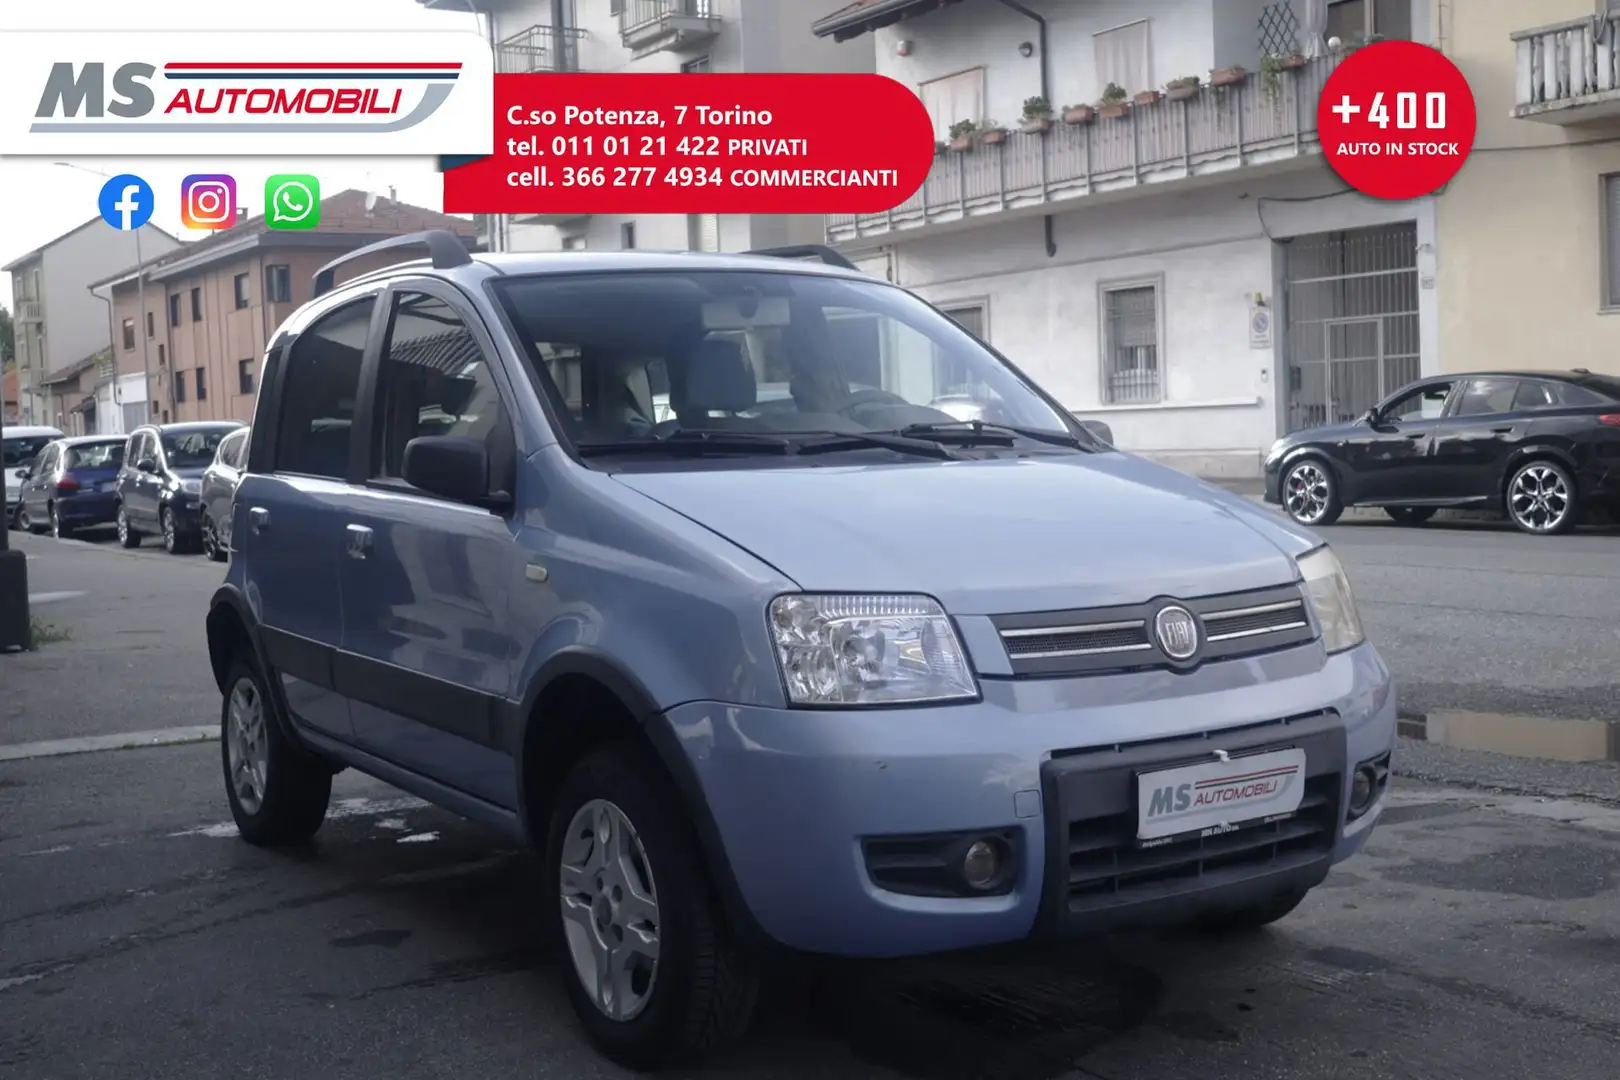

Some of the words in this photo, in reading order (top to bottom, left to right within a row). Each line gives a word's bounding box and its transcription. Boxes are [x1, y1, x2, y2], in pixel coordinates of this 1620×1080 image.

[1164, 621, 1190, 646] FIAT
[1148, 783, 1191, 818] MS
[1194, 780, 1278, 807] AUTOMOBILI
